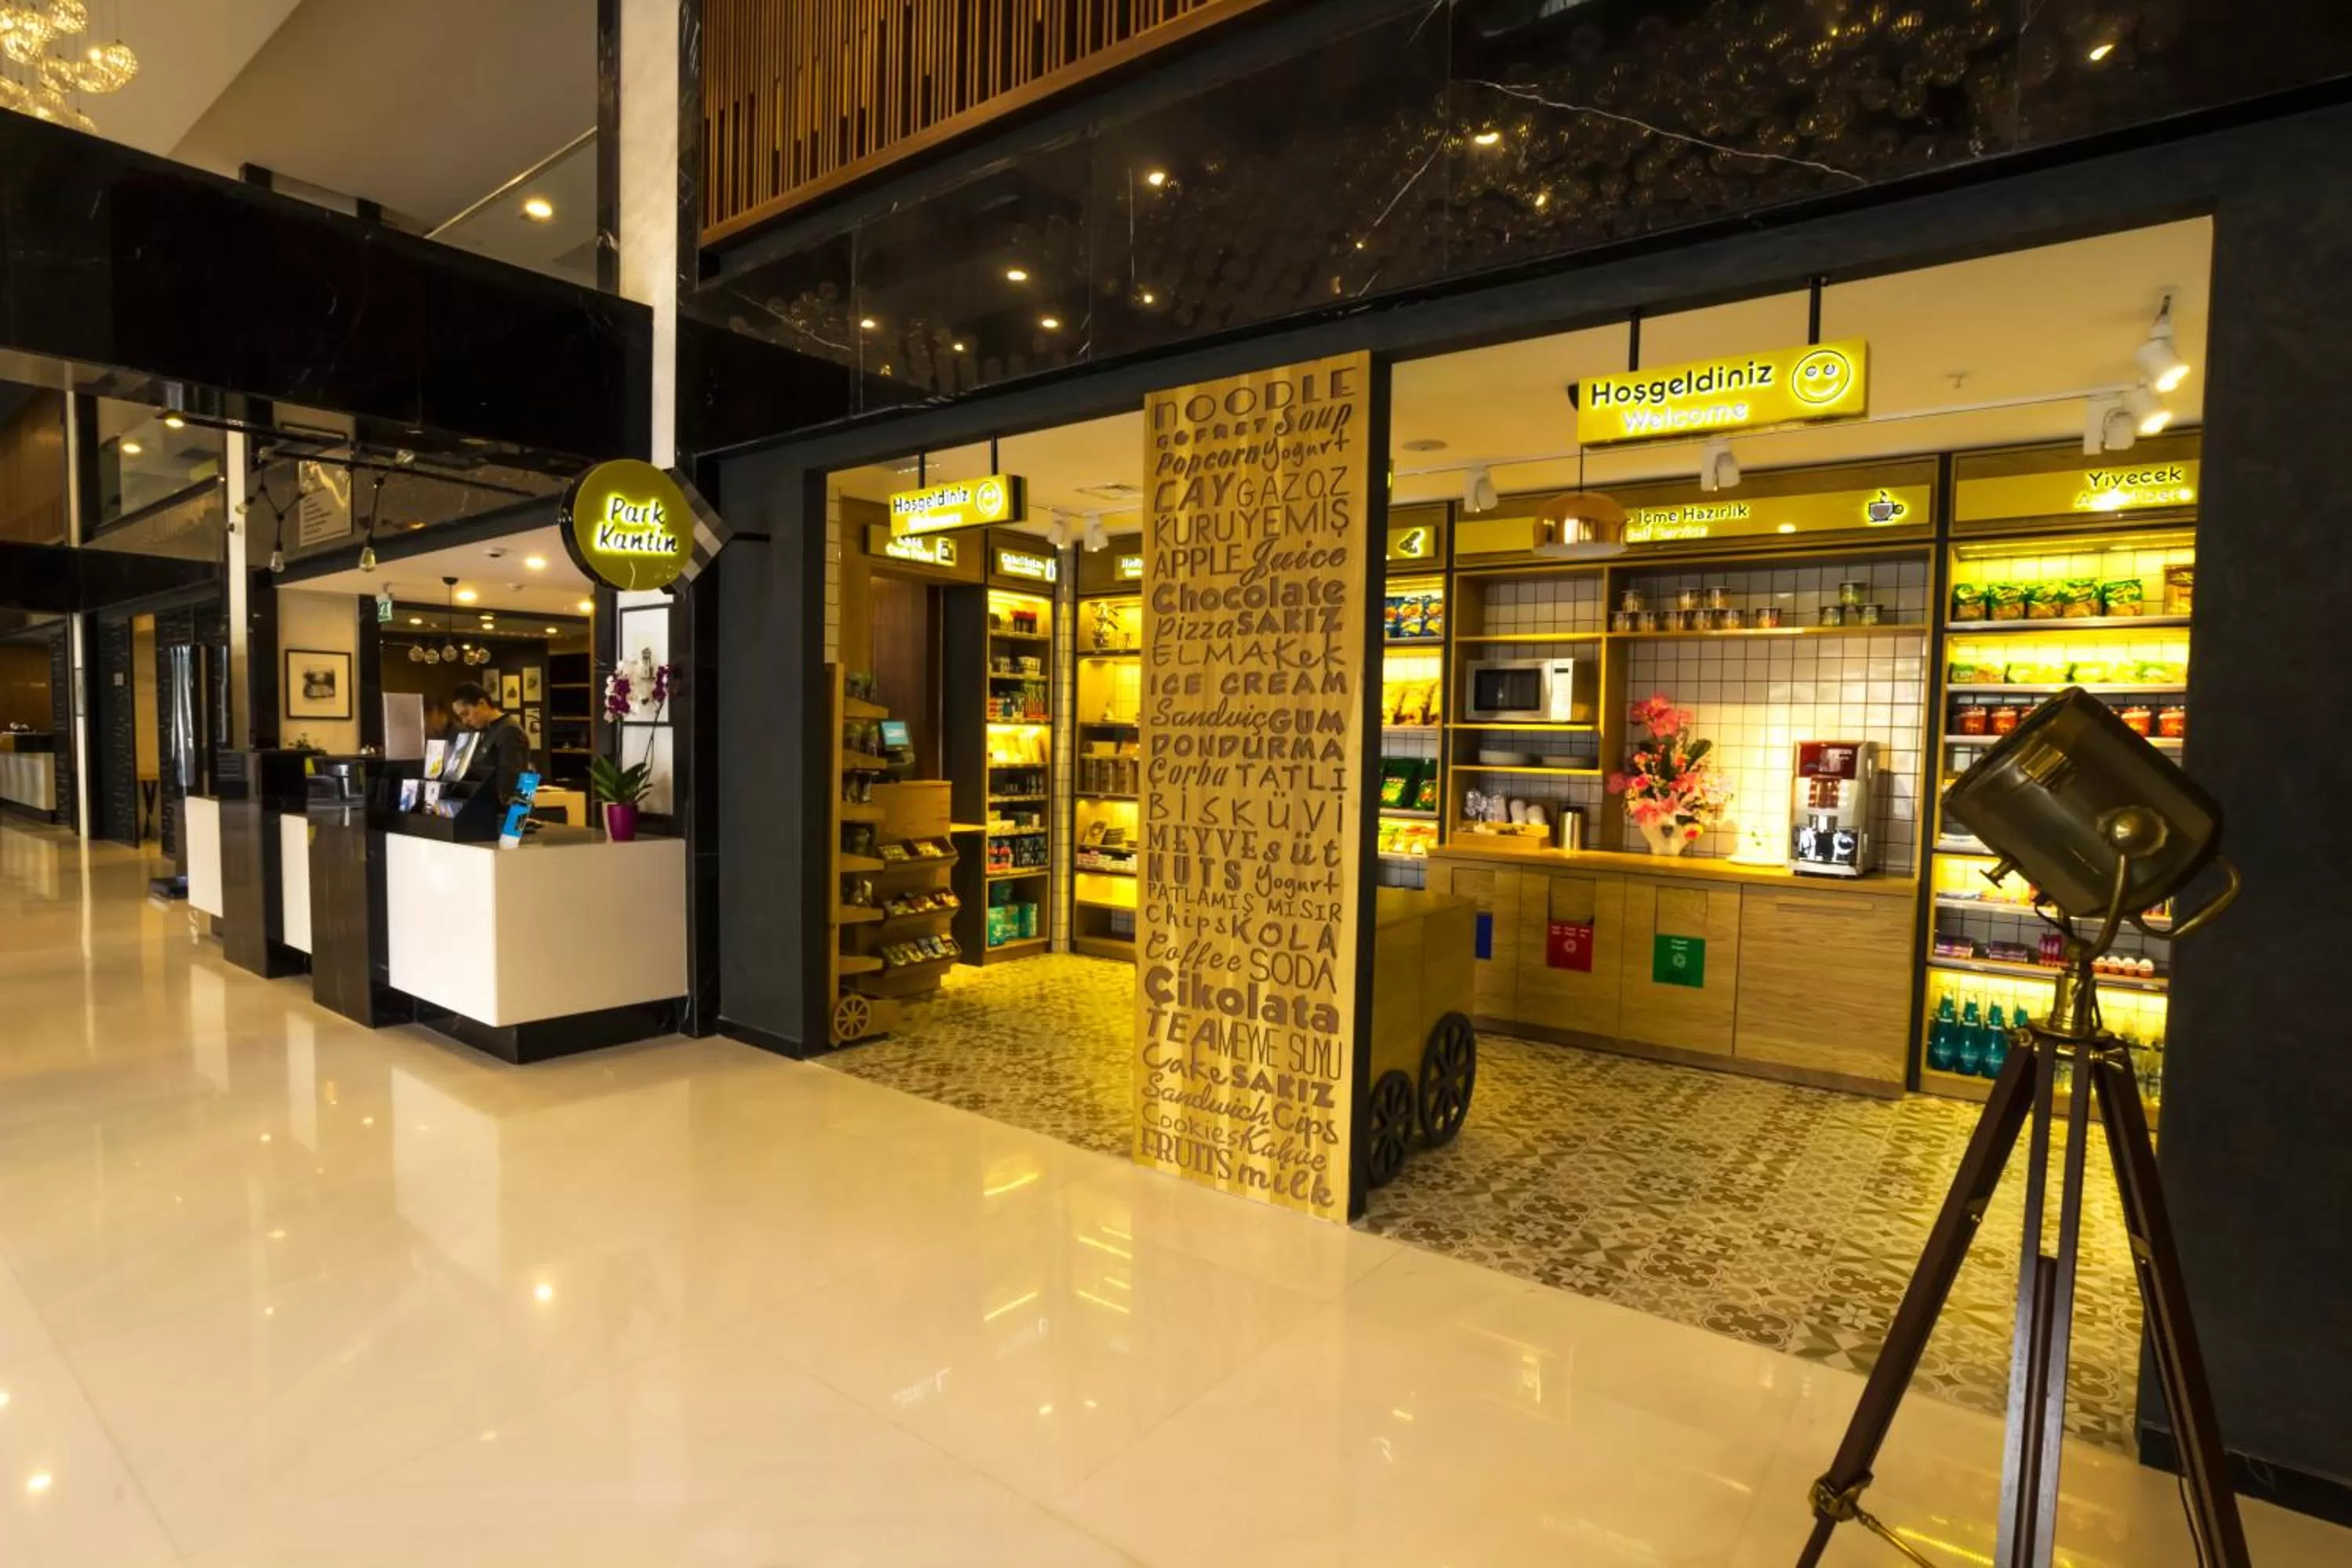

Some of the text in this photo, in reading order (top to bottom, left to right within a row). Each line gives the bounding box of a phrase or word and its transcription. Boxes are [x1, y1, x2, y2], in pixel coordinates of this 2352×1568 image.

[1592, 360, 1773, 406] Hoşgeldiniz
[1623, 401, 1748, 433] Welcome
[1236, 466, 1350, 508] GAZOZ
[2089, 466, 2183, 489] Yiyecek
[610, 496, 666, 524] Park
[597, 522, 678, 553] Kantin
[1152, 543, 1243, 580] APPLE
[1152, 575, 1346, 615] Chocolate
[1236, 606, 1344, 637] SAKIZ
[1152, 641, 1269, 667] ELMA
[1149, 670, 1348, 697] ICE CREAM
[1268, 707, 1346, 736] GUM
[1151, 733, 1345, 762] DONDURMA
[1235, 763, 1348, 793] TATLI
[1145, 822, 1258, 861] MEYVE
[1147, 851, 1243, 891] NUTS
[1265, 897, 1343, 924] MISIR
[1231, 913, 1338, 960] KOLA
[1249, 947, 1338, 995] SODA
[1146, 1007, 1343, 1082] TEA MEYVE SUYU
[1142, 1040, 1336, 1109] Cake SAKIZ
[1141, 1072, 1340, 1148] Sandwich Cips
[1141, 1102, 1242, 1147] Cookies
[1141, 1125, 1233, 1181] FRUITS
